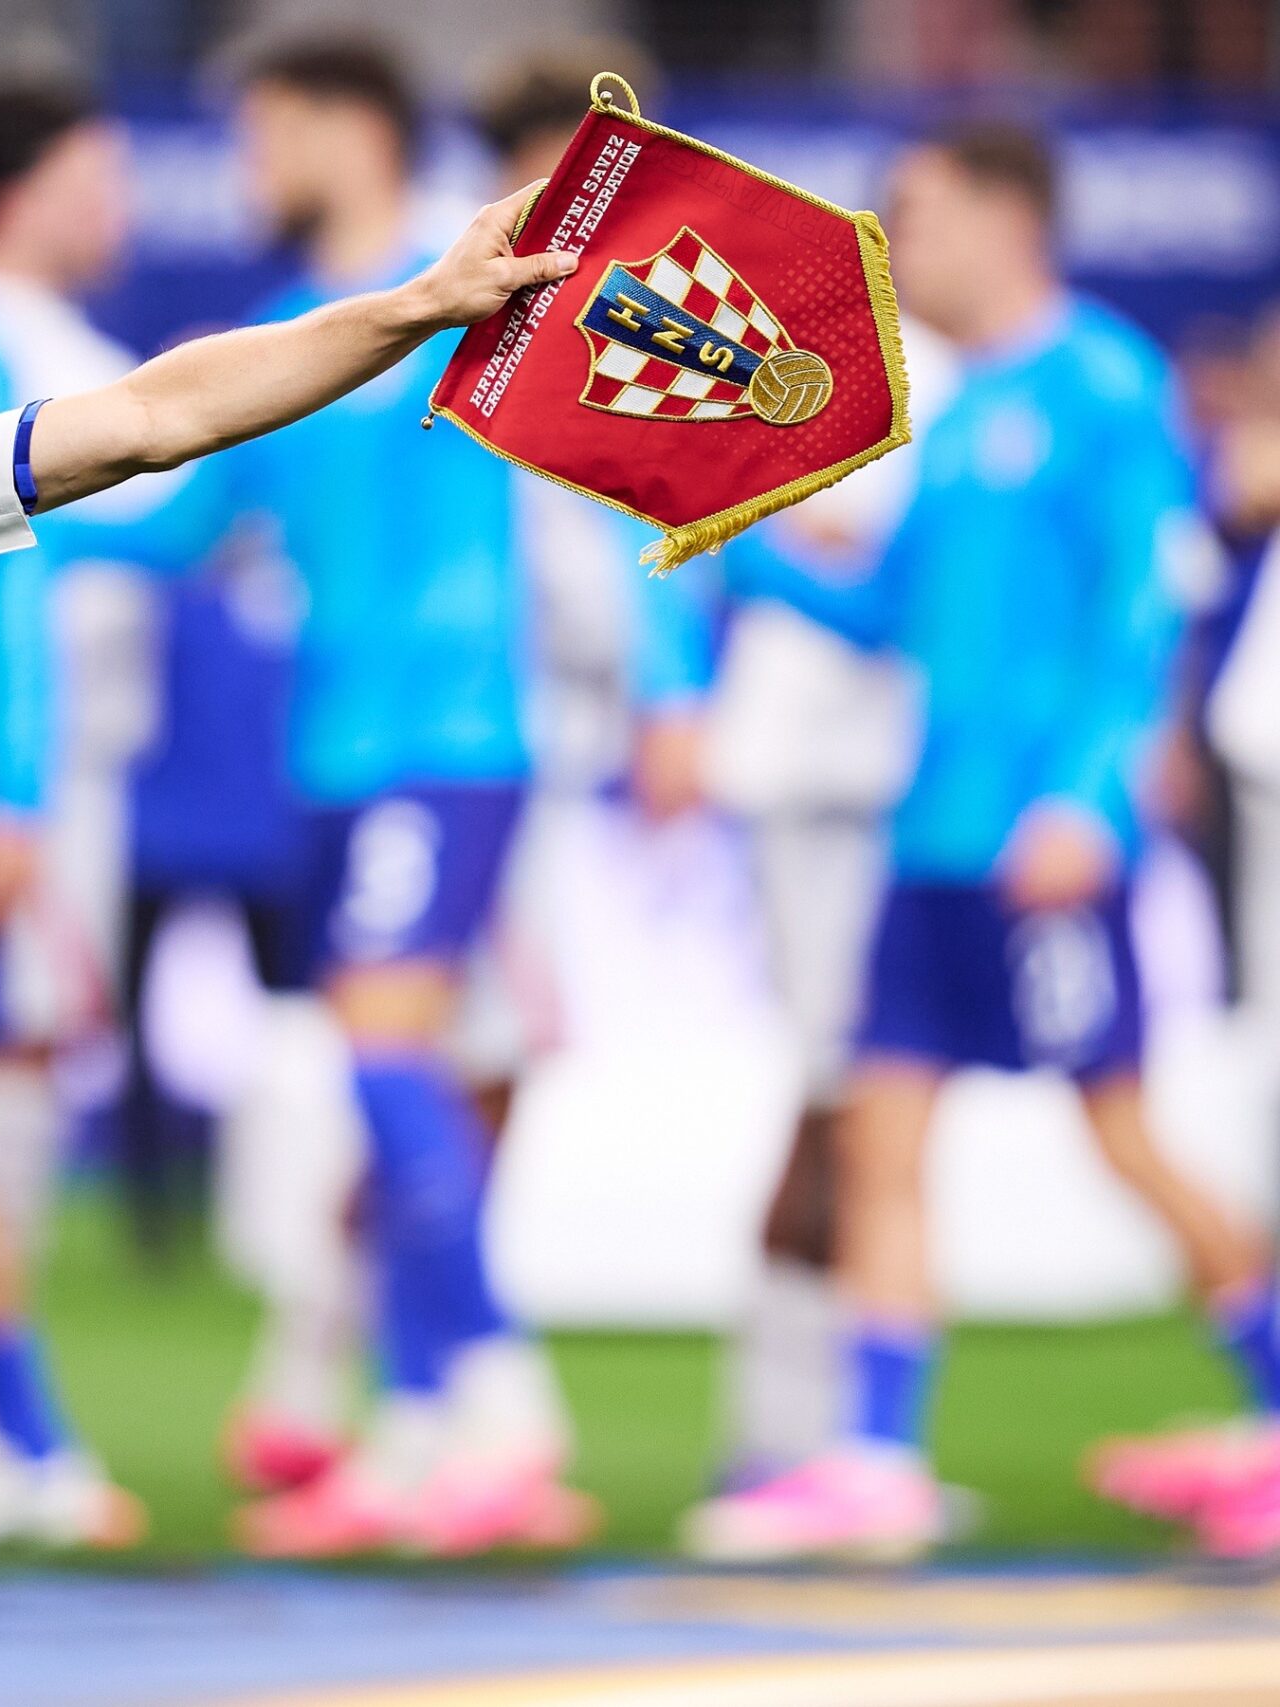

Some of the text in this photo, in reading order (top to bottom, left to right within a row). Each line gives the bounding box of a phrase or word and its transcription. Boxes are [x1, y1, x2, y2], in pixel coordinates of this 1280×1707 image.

[469, 134, 625, 408] HRVATSKI NMETNI SAVEZ
[481, 141, 643, 418] CROATIAN FOOTL FEDERATION
[606, 292, 735, 374] HNS
